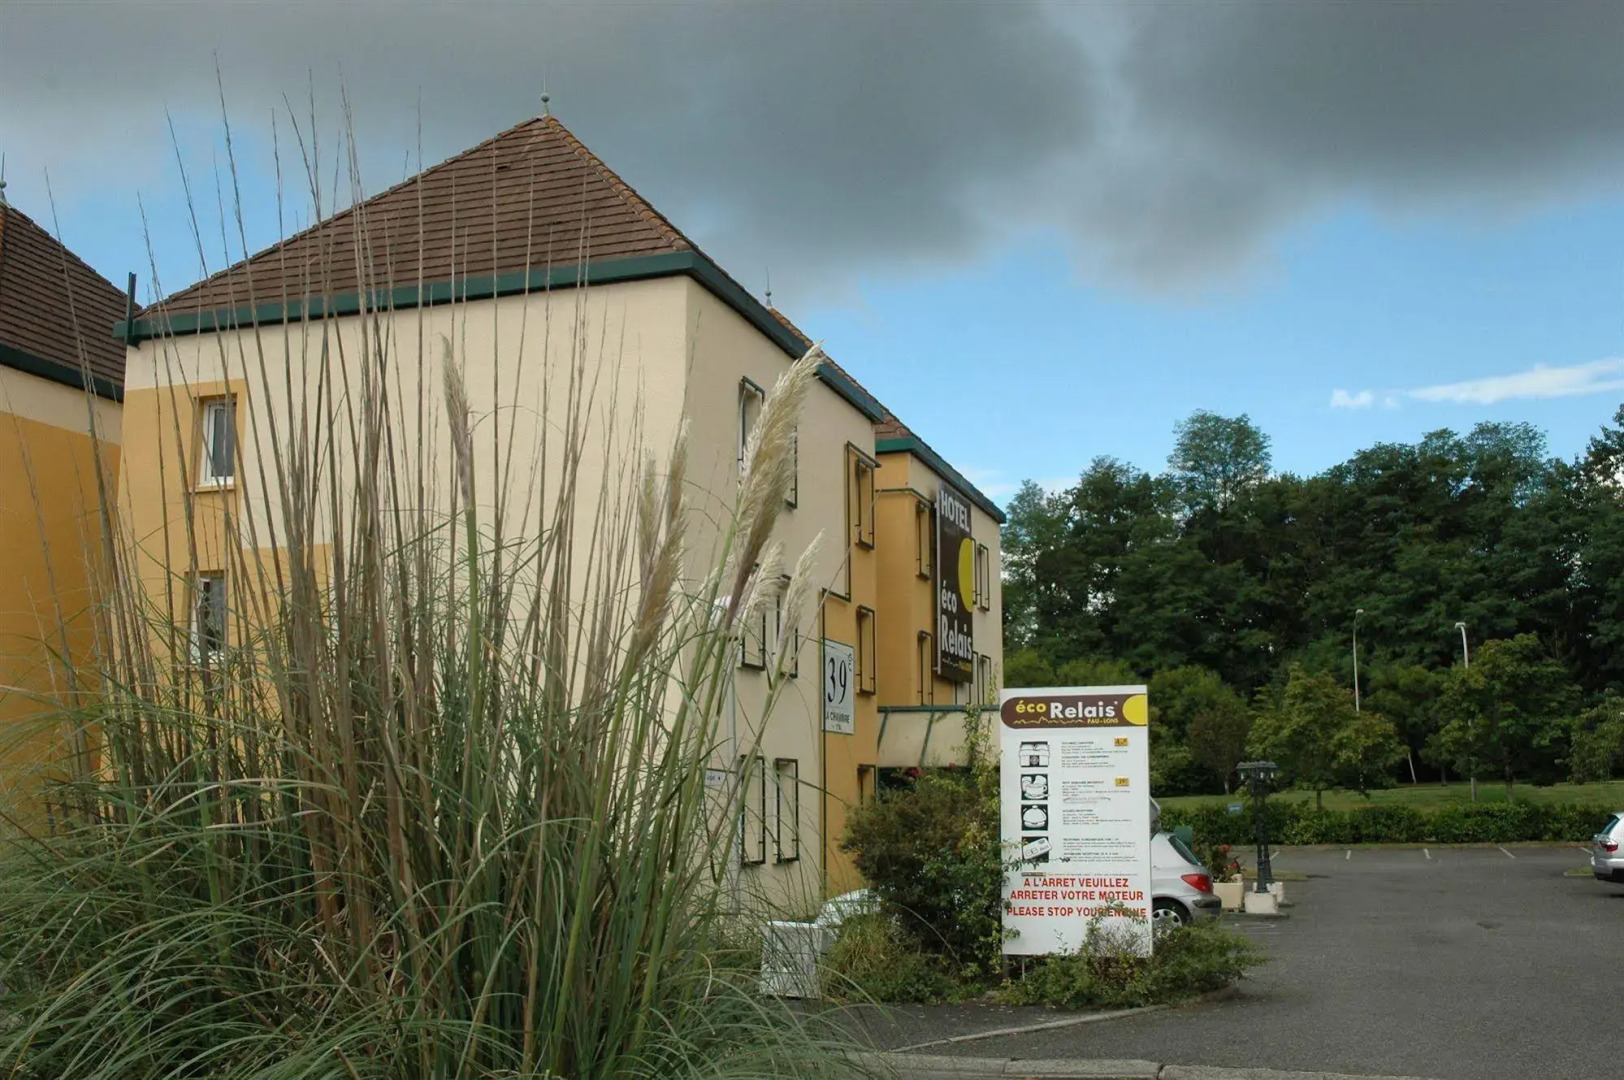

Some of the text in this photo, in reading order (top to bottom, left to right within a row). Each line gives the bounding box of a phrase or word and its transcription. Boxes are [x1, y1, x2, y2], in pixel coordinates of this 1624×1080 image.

[940, 490, 970, 533] HOTEL
[941, 580, 957, 614] éco
[941, 614, 972, 660] Relais
[827, 657, 847, 705] 39
[1015, 700, 1116, 719] éco Relais
[1010, 891, 1144, 901] ARRETER VOTRE MOTEUR
[1024, 878, 1129, 888] A L'ARRET VEUILLEZ
[1006, 907, 1044, 916] PLEASE
[1048, 907, 1074, 916] STOP
